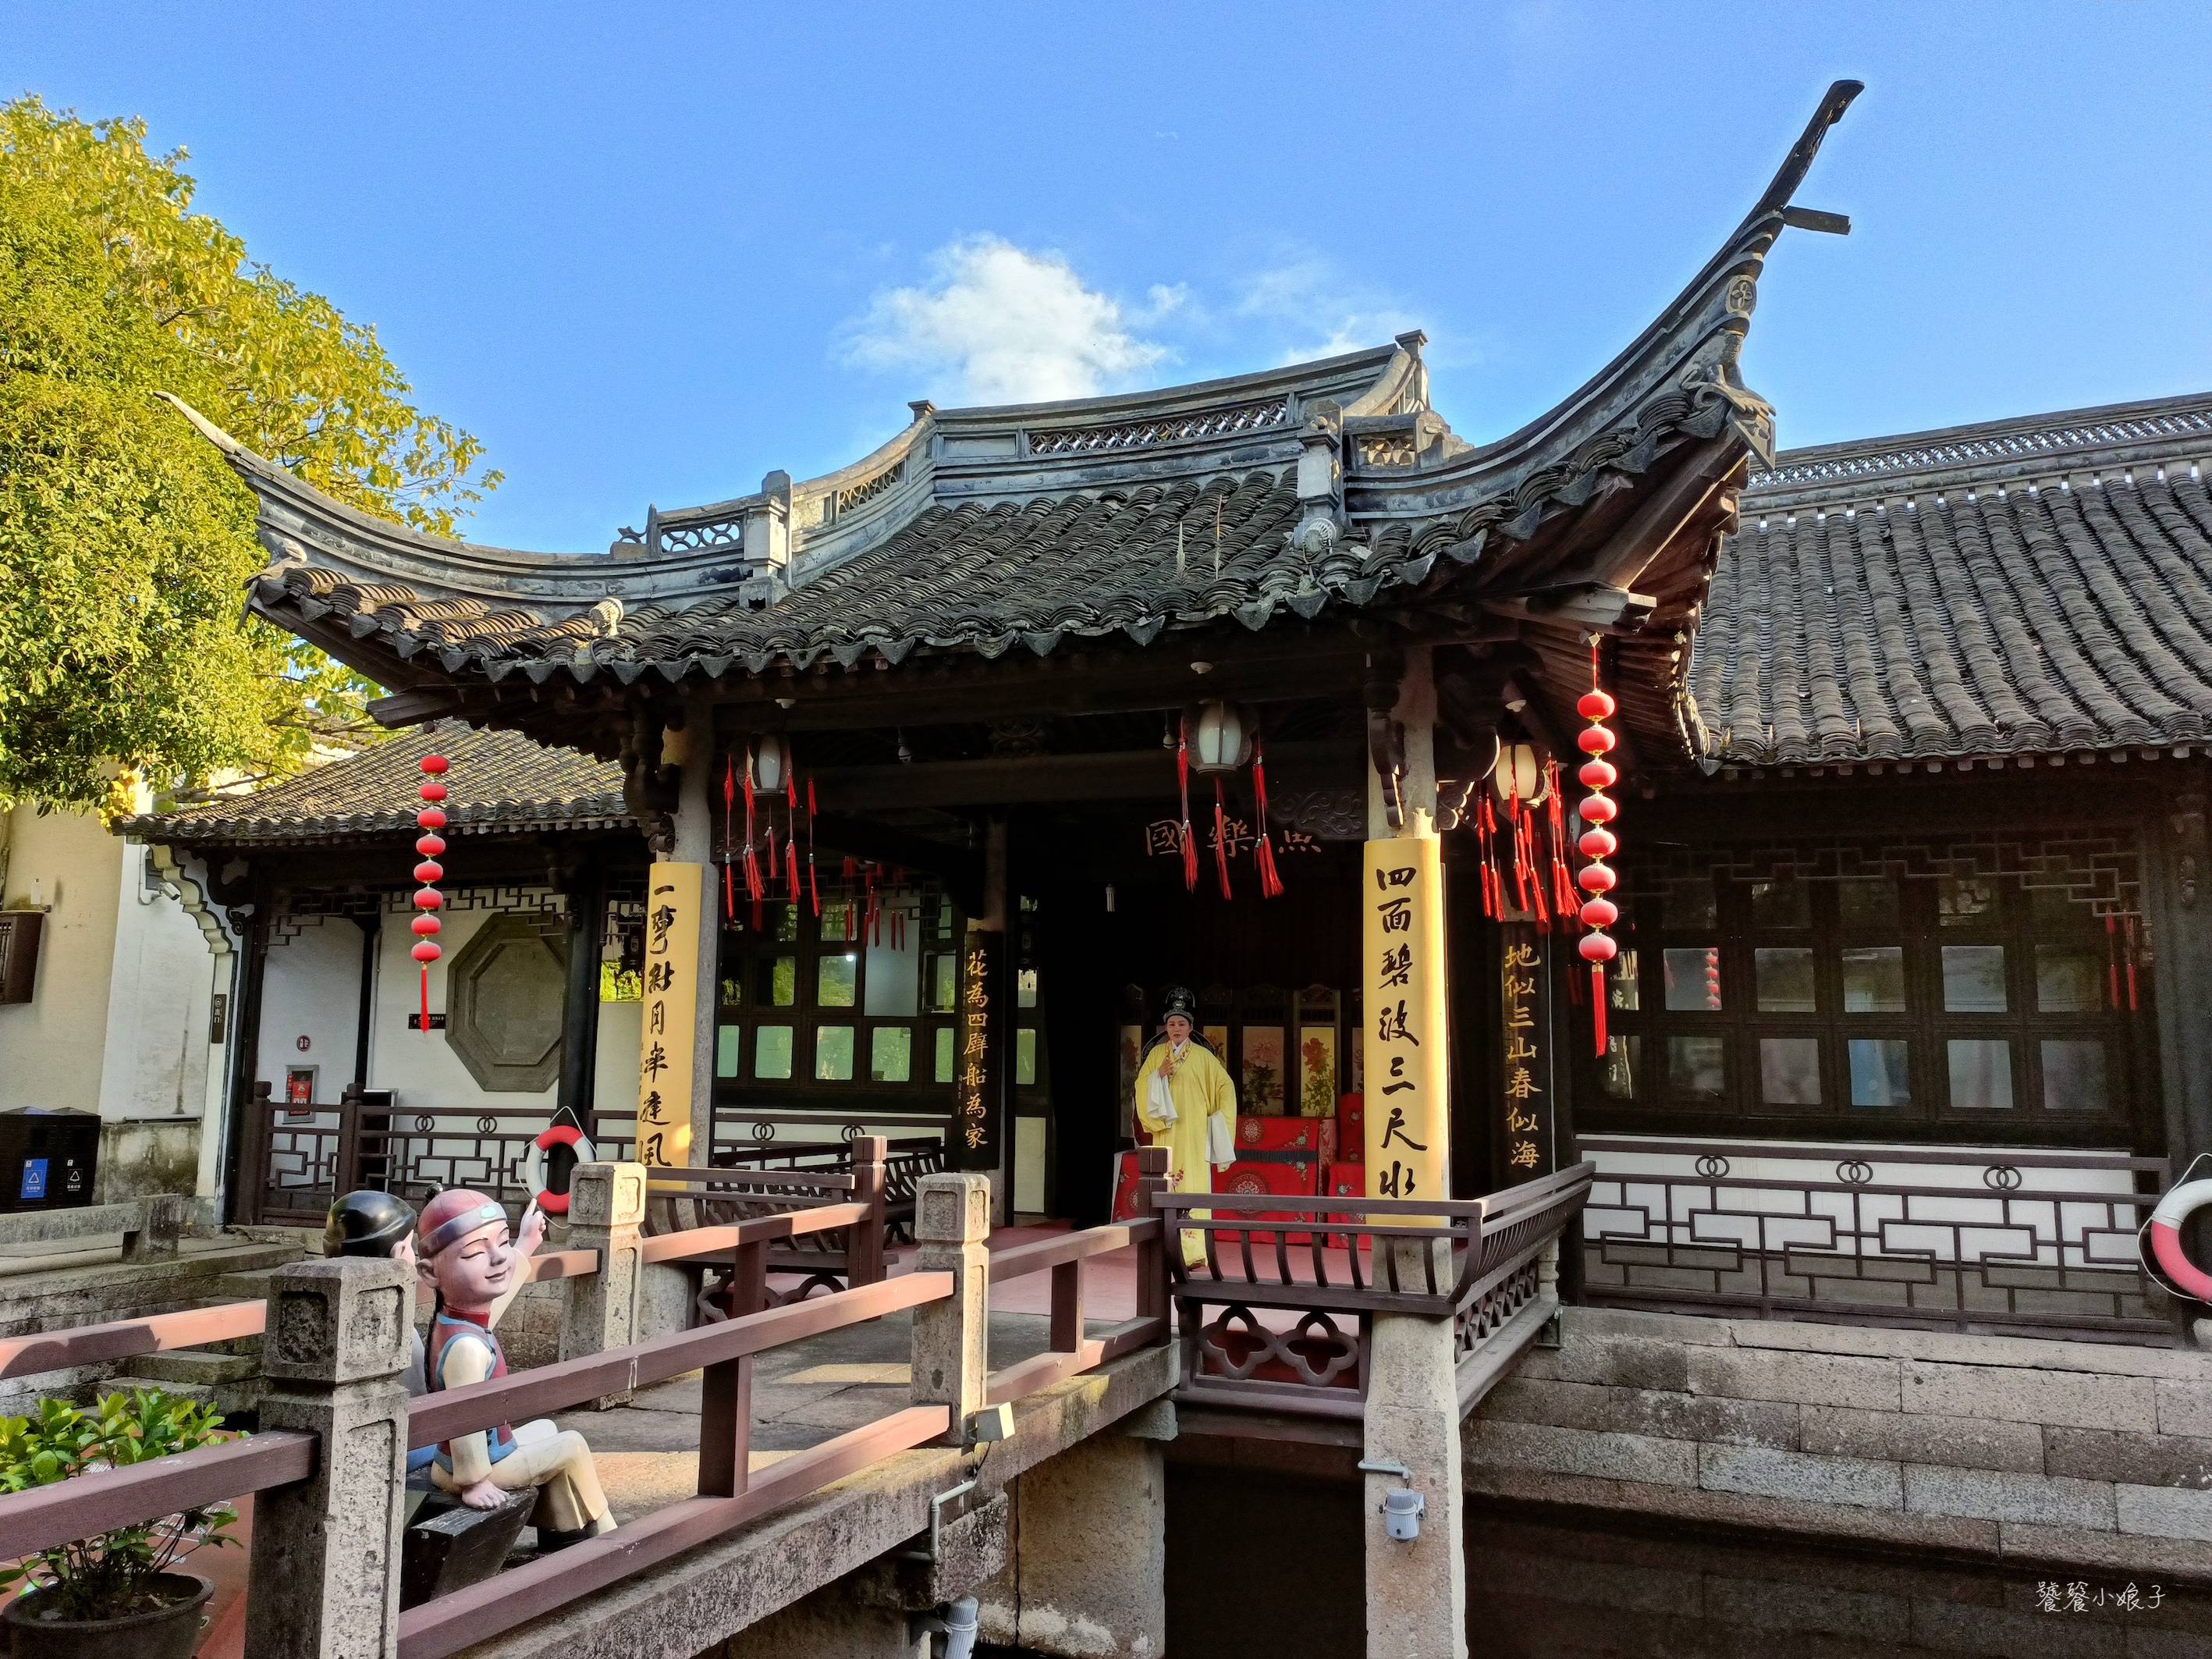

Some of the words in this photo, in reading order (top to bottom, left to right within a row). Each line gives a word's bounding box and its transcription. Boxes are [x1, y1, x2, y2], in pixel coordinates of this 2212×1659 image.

[963, 949, 989, 1149] 花為四壁船為家
[1376, 867, 1427, 1199] 四面碧波三尺水
[1504, 943, 1543, 1169] 地似三山春似海
